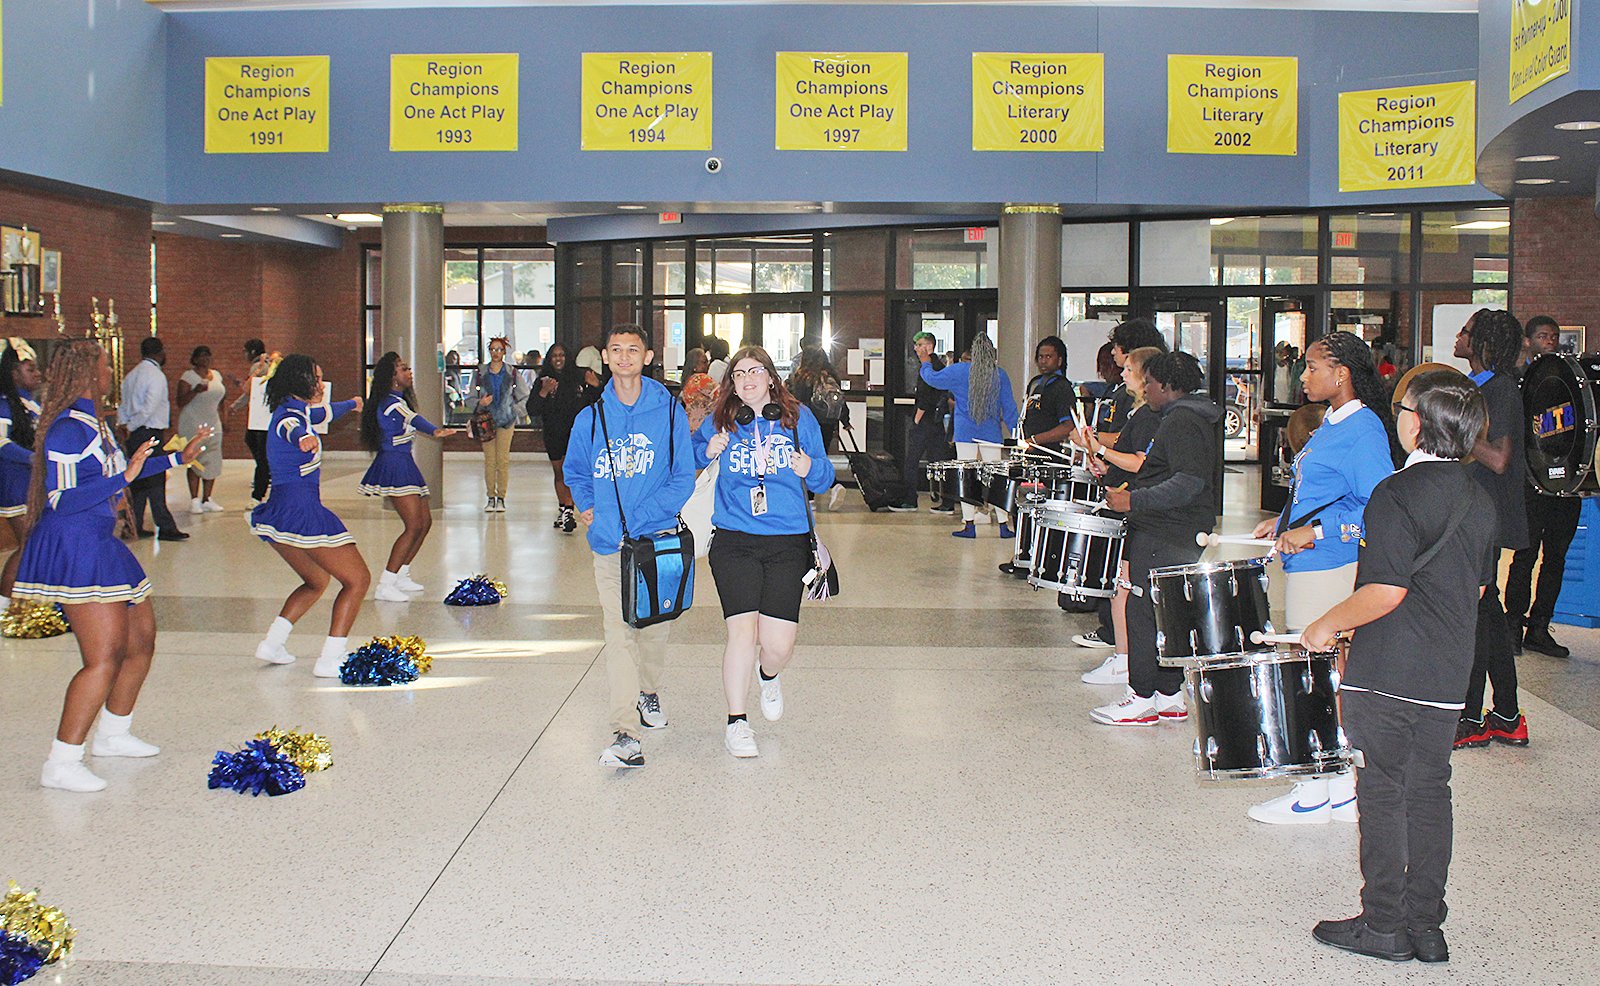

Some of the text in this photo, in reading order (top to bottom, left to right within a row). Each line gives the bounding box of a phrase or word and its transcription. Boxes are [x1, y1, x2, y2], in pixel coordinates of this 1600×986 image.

[1548, 36, 1568, 67] Guard
[241, 64, 294, 81] Region
[427, 61, 483, 79] Region
[619, 60, 676, 78] Region
[813, 60, 871, 78] Region
[1010, 60, 1067, 78] Region
[1205, 63, 1262, 82] Region
[223, 84, 311, 102] Champions
[409, 81, 499, 99] Champions
[601, 80, 693, 98] Champions
[795, 79, 889, 98] Champions
[992, 80, 1085, 98] Champions
[1187, 83, 1279, 102] Champions
[404, 104, 505, 122] One Act Play
[595, 103, 699, 121] One Act Play
[789, 103, 894, 122] One Act Play
[1008, 104, 1070, 122] Literary
[1376, 95, 1436, 114] Region
[217, 107, 316, 124] One Act Play
[1202, 106, 1264, 125] Literary
[1358, 115, 1455, 135] Champions
[249, 131, 283, 145] 1991
[436, 129, 473, 143] 1993
[628, 128, 666, 142] 1994
[823, 128, 861, 142] 1997
[1019, 129, 1058, 144] 2000
[1213, 131, 1252, 146] 2002
[1374, 141, 1439, 157] Literary
[1387, 165, 1423, 181] 2011
[967, 227, 985, 241] EXIT
[1335, 233, 1353, 246] EXIT
[1539, 405, 1575, 435] MTB
